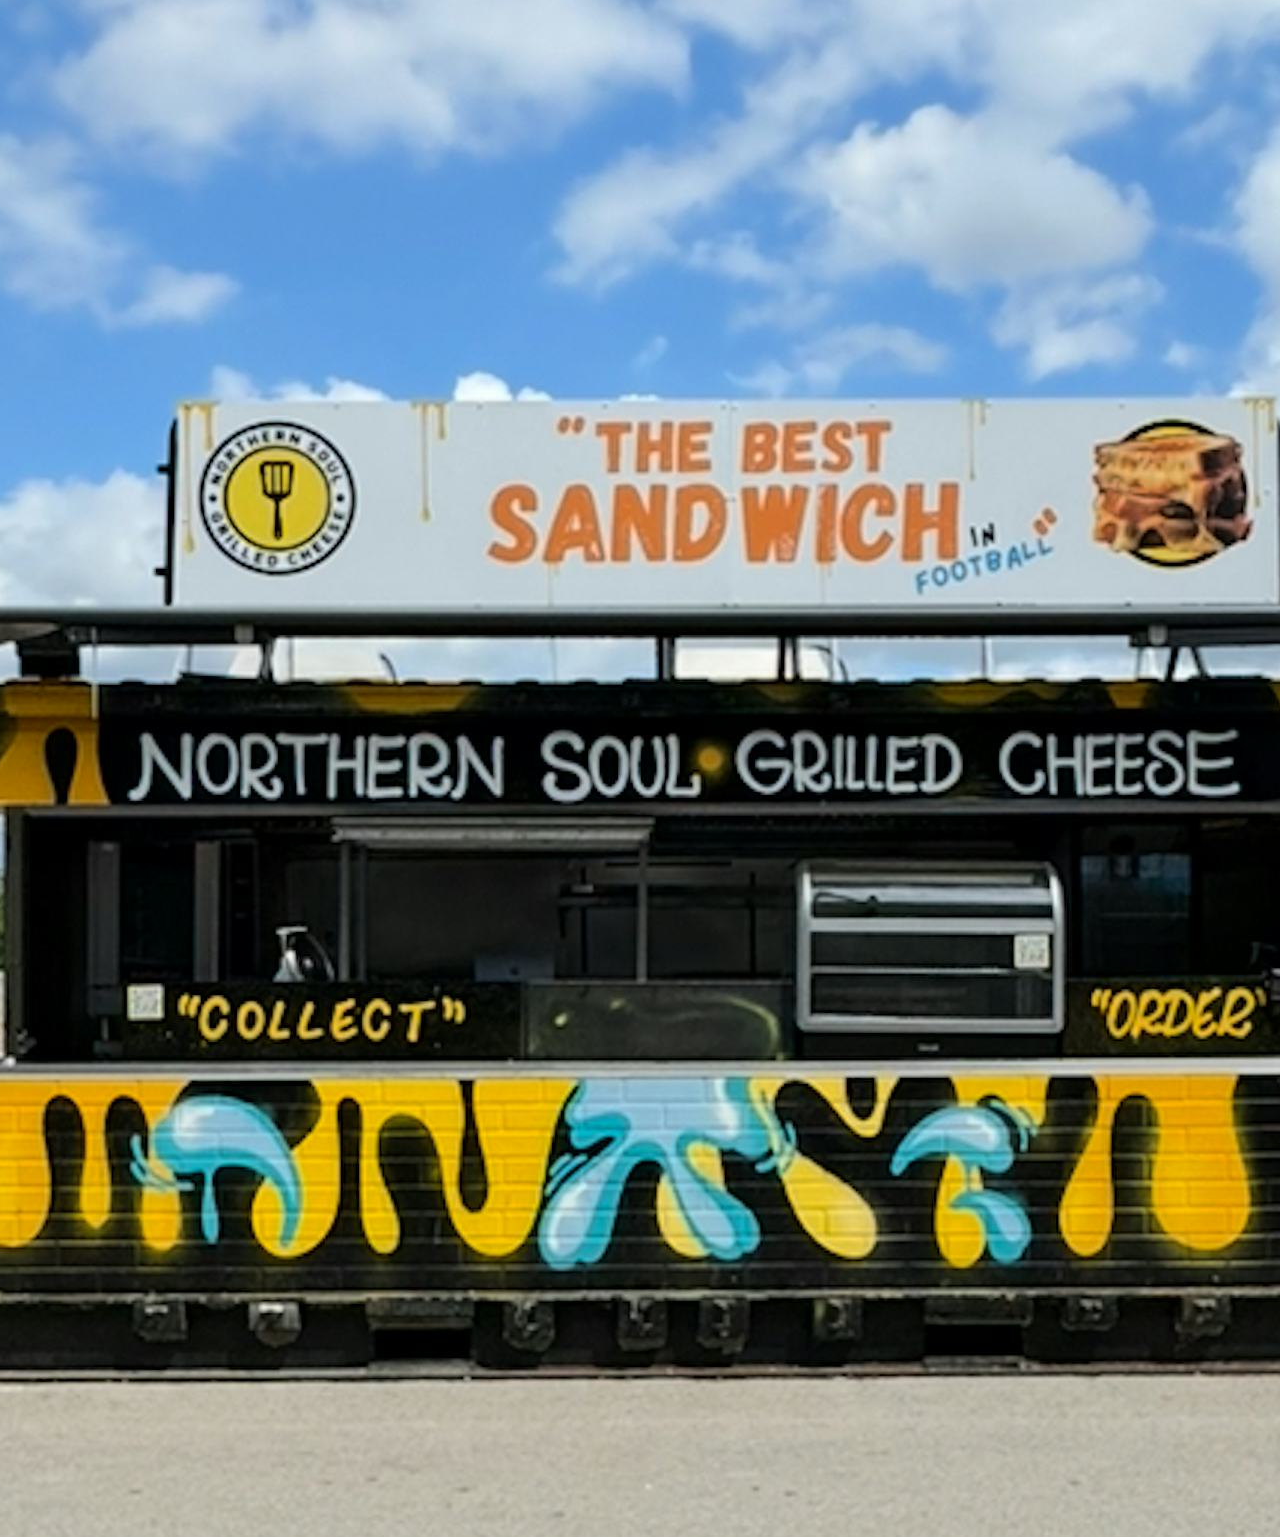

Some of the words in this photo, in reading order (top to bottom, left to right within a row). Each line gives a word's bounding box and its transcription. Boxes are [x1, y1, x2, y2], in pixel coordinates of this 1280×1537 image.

[210, 430, 301, 484] NORTHERN
[308, 442, 343, 484] SOUL
[741, 420, 893, 473] BEST
[211, 512, 279, 568] GRILLED
[287, 512, 345, 565] CHEESE
[488, 482, 960, 563] SANDWICH
[969, 523, 996, 547] IN
[128, 731, 503, 802] NORTHERN
[541, 730, 701, 803] SOUL
[736, 729, 963, 795] GRILLED
[999, 729, 1241, 796] CHEESE
